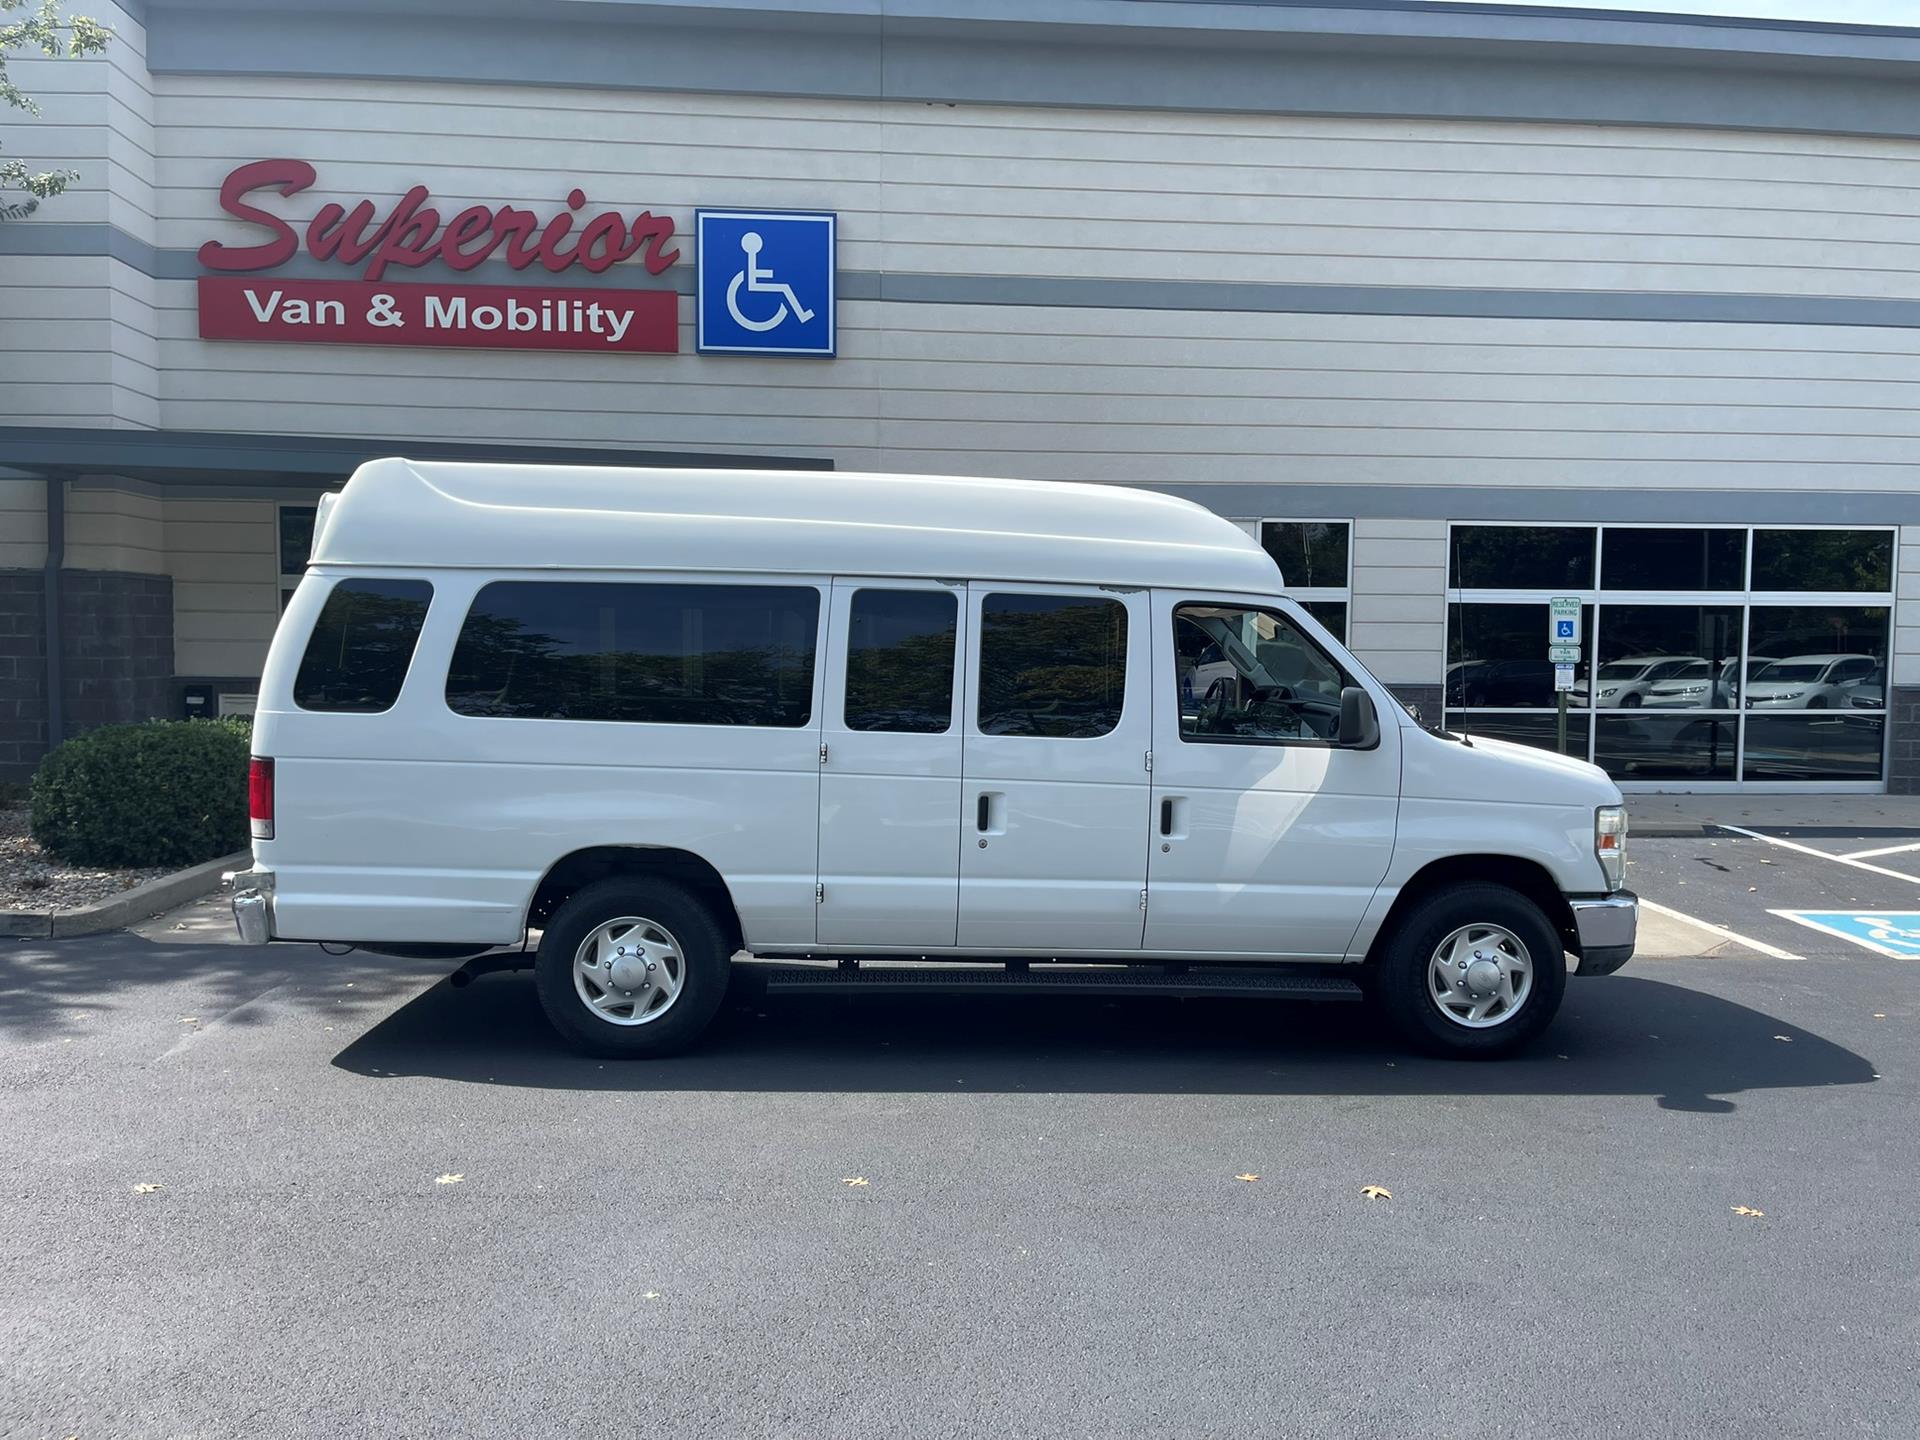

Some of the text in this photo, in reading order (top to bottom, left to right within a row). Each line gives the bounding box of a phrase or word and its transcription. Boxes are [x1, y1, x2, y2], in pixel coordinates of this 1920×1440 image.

[198, 158, 680, 282] Superior
[243, 289, 636, 343] Van & Mobility
